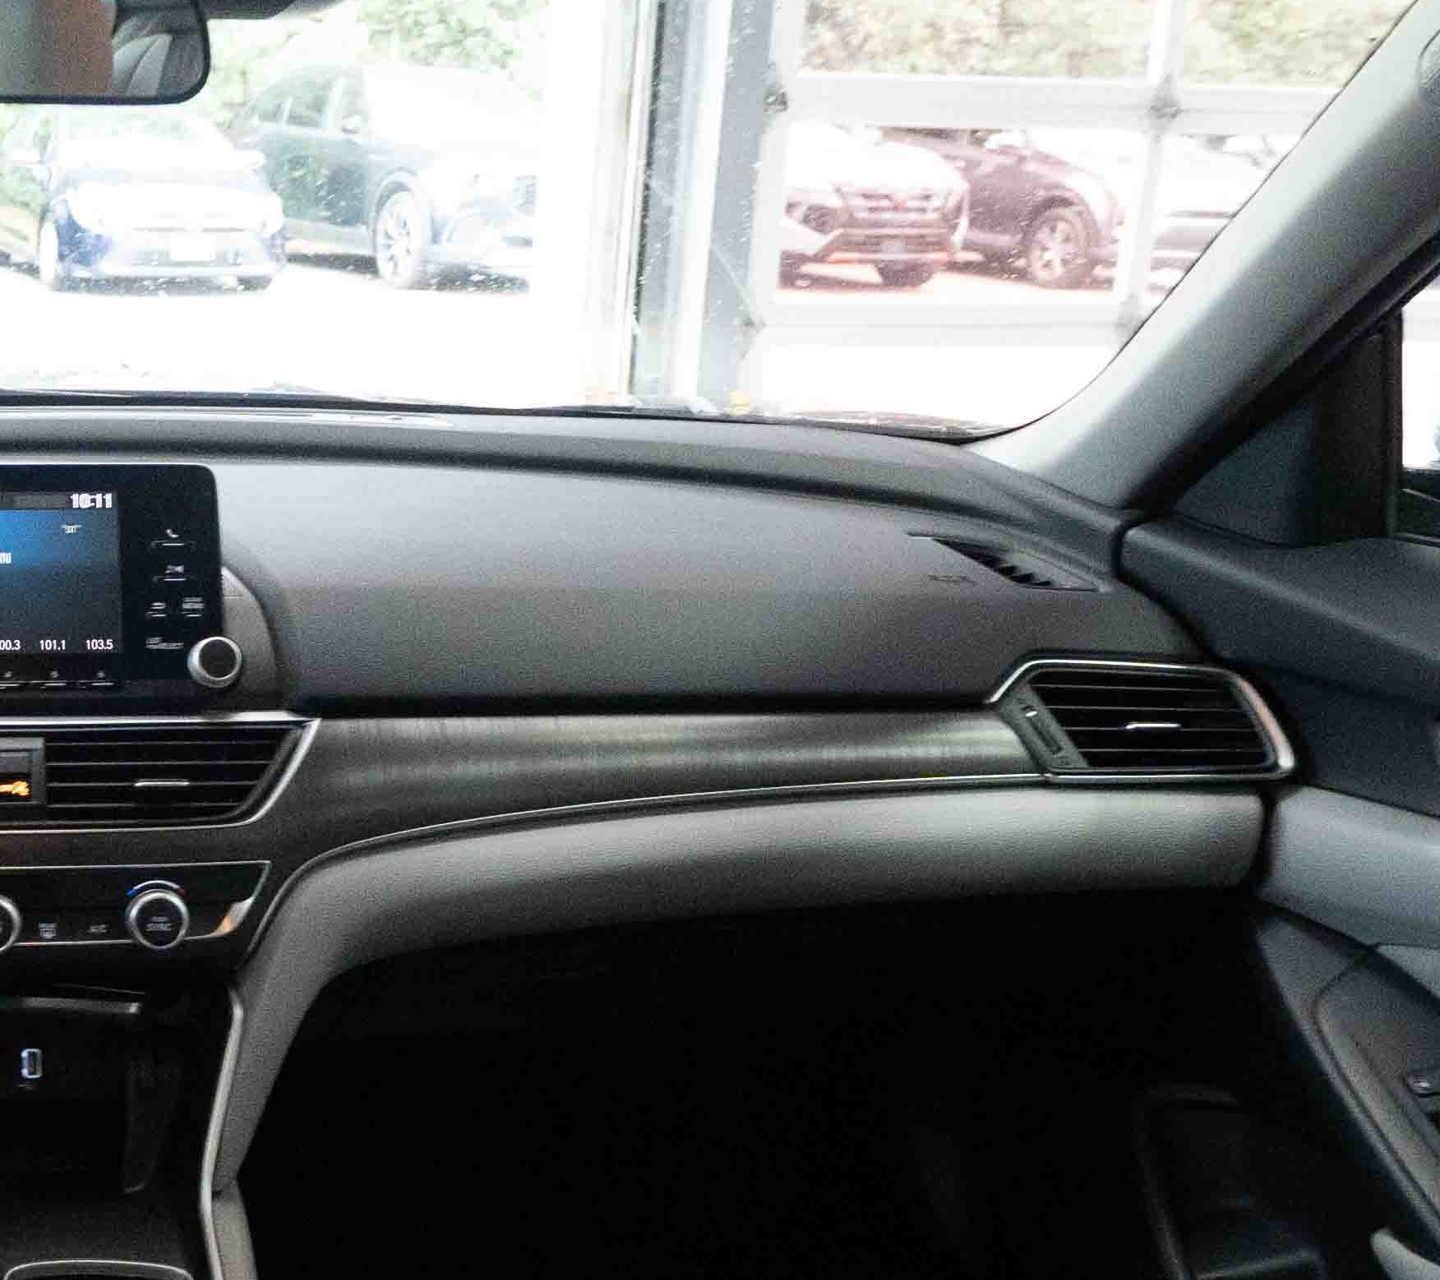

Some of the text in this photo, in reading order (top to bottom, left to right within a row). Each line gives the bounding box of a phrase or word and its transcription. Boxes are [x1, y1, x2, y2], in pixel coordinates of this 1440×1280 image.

[70, 493, 112, 508] 10:11
[39, 639, 66, 650] 101.1
[85, 639, 113, 650] 103.5
